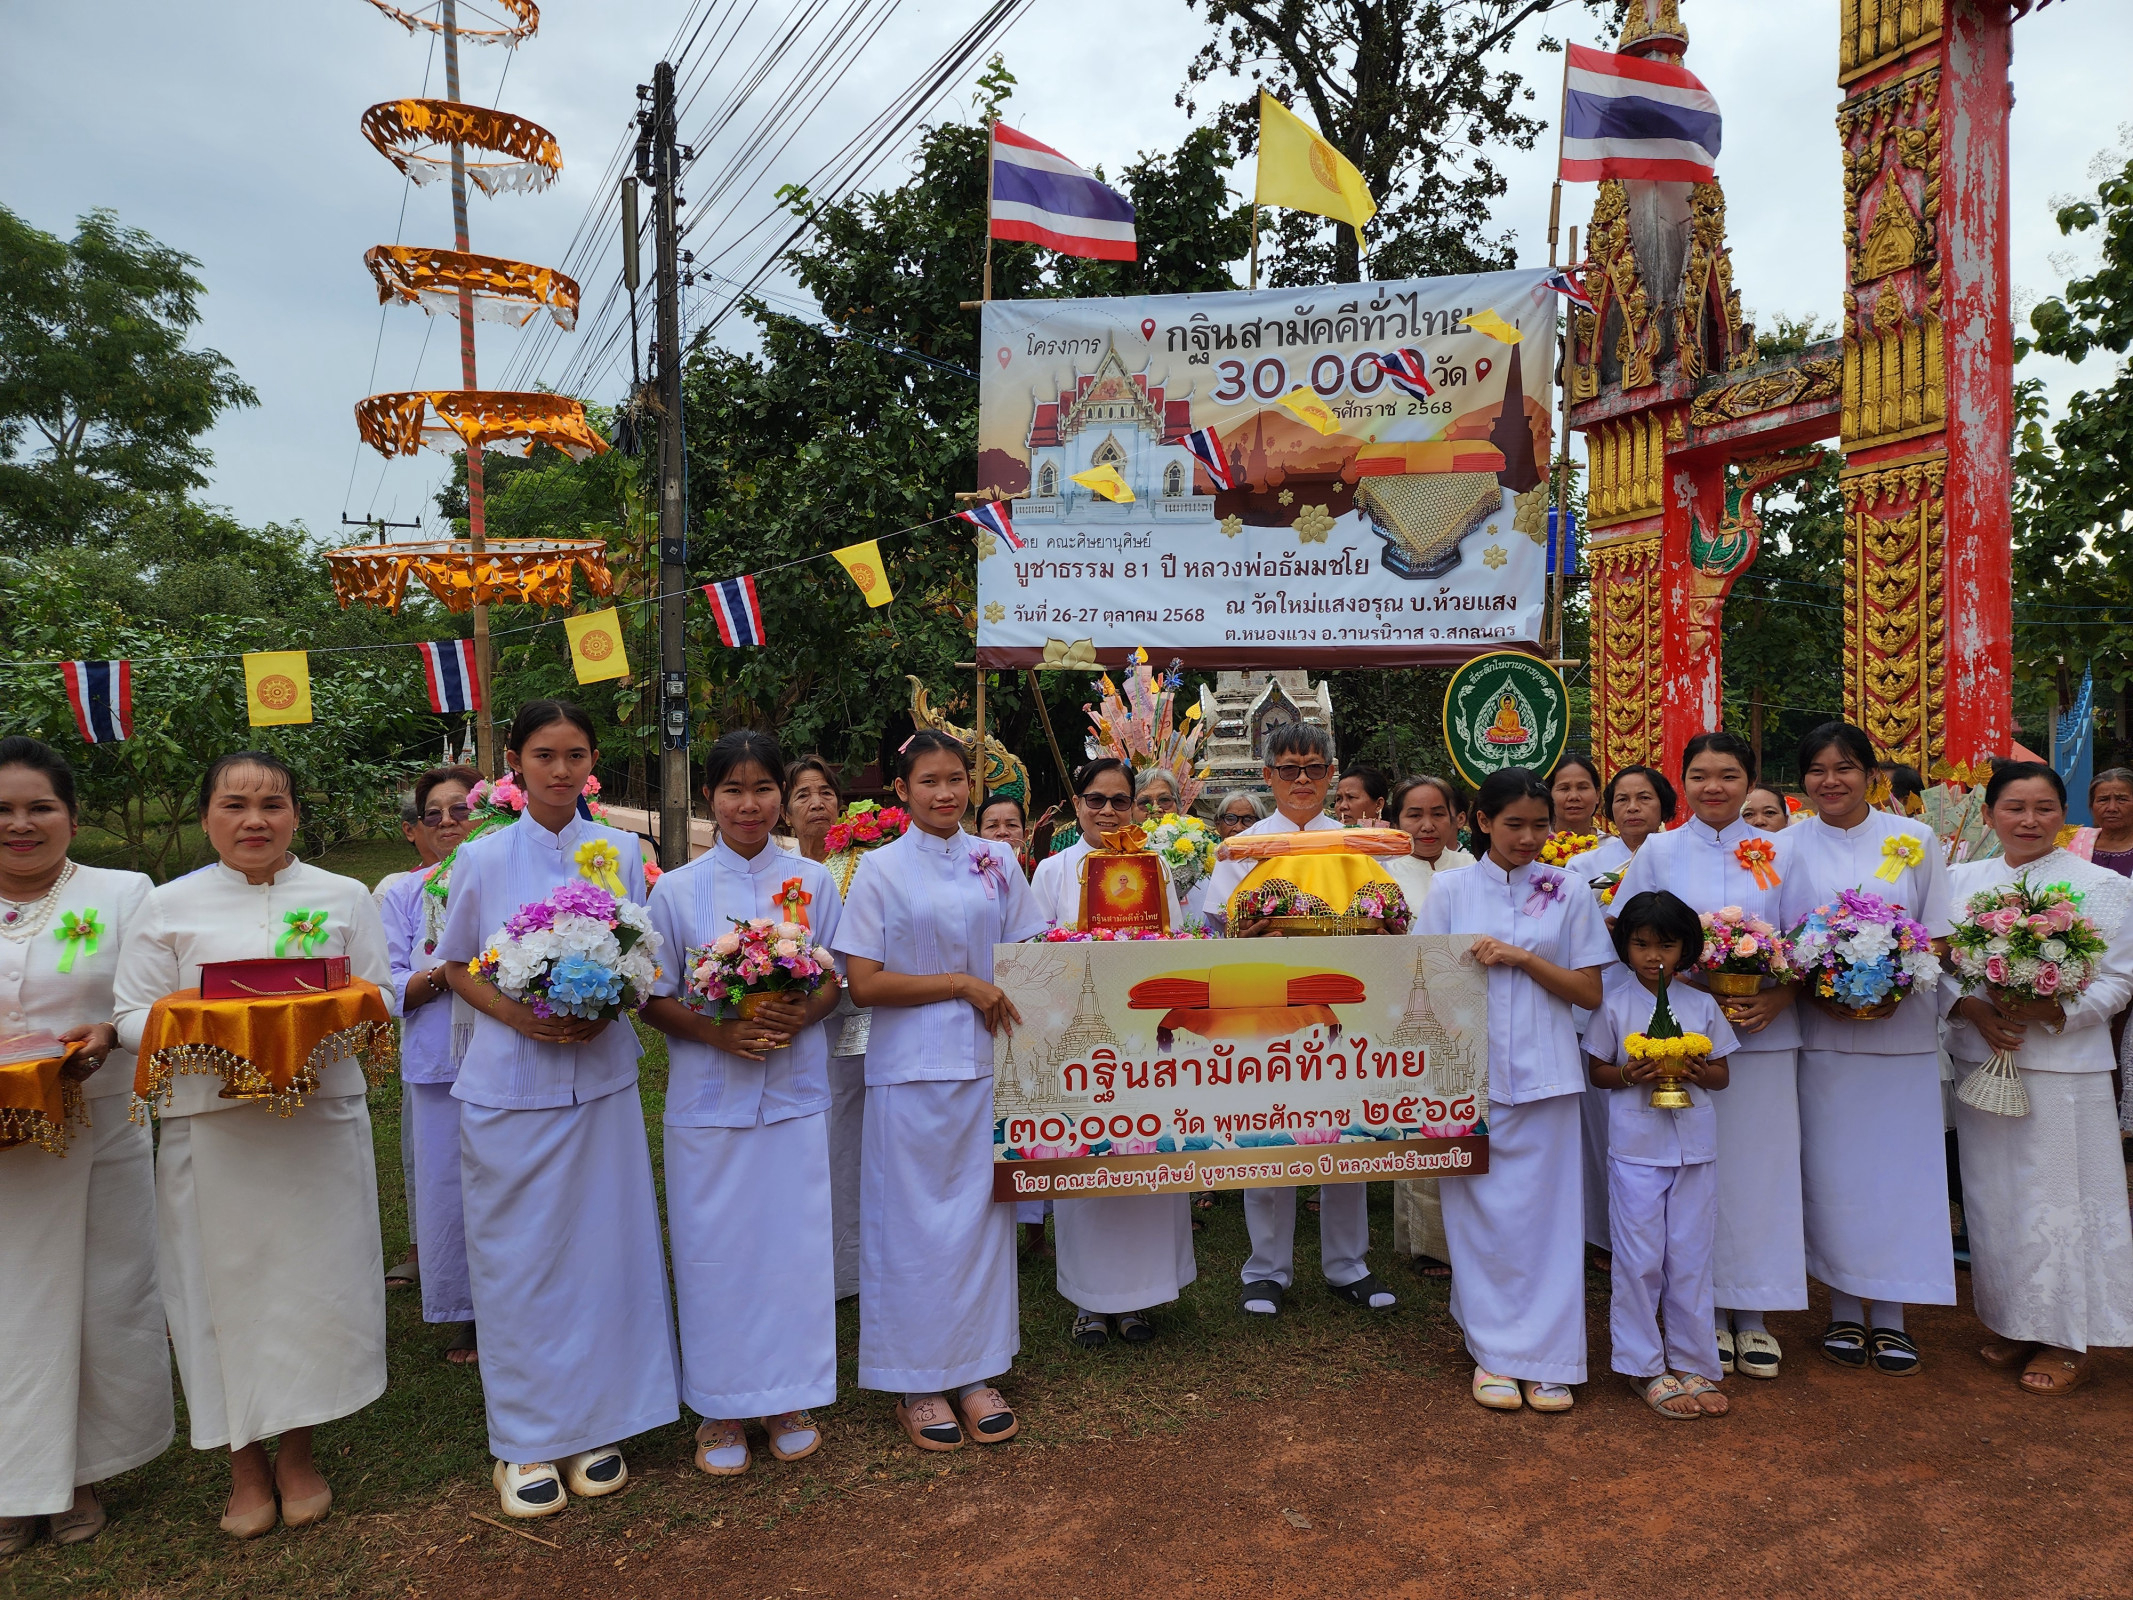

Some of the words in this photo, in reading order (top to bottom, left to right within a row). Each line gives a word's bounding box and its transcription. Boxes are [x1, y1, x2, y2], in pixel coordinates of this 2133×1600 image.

[1165, 286, 1473, 366] กฐินสามัคคีทั่วไทย
[1026, 333, 1101, 356] โครงการ
[1431, 355, 1467, 387] วัด
[1407, 401, 1452, 416] 2568
[1046, 531, 1152, 554] คณะศิษยานุศิษย์
[1013, 559, 1114, 587] บูชาธรรม
[1124, 562, 1148, 578] 81
[1160, 552, 1176, 578] ปี
[1183, 546, 1369, 578] หลวงพ่อธัมมชโย
[1013, 599, 1047, 622] วันที่
[1051, 608, 1099, 622] 26-27
[1103, 608, 1157, 628] ตุลาคม
[1162, 608, 1205, 622] 2568
[1226, 599, 1245, 615] ณ
[1251, 590, 1404, 620] วัดใหม่แสงอรุณ
[1410, 587, 1517, 612] บ.ห้วยแสง
[1225, 628, 1316, 641] ต.หนองแวง
[1321, 623, 1424, 641] อ.วานรนิวาส
[1429, 624, 1516, 640] จ.สกลนคร
[1063, 1028, 1425, 1103] กฐินสามัคคีทั่วไทย
[1009, 1113, 1162, 1146] ๓๐,๐๐๐
[1173, 1108, 1205, 1135] วัด
[1213, 1103, 1351, 1142] พุทธศักราช
[1362, 1094, 1476, 1126] ๒๕๖๘
[1014, 1172, 1048, 1192] โดย
[1055, 1163, 1195, 1192] คณะศิษยานุศิษย์
[1201, 1162, 1282, 1186] บูชาธรรม
[1289, 1160, 1313, 1177] ๘๑
[1319, 1155, 1332, 1174] ปี
[1338, 1148, 1471, 1173] หลวงพ่อธัมมชโย
